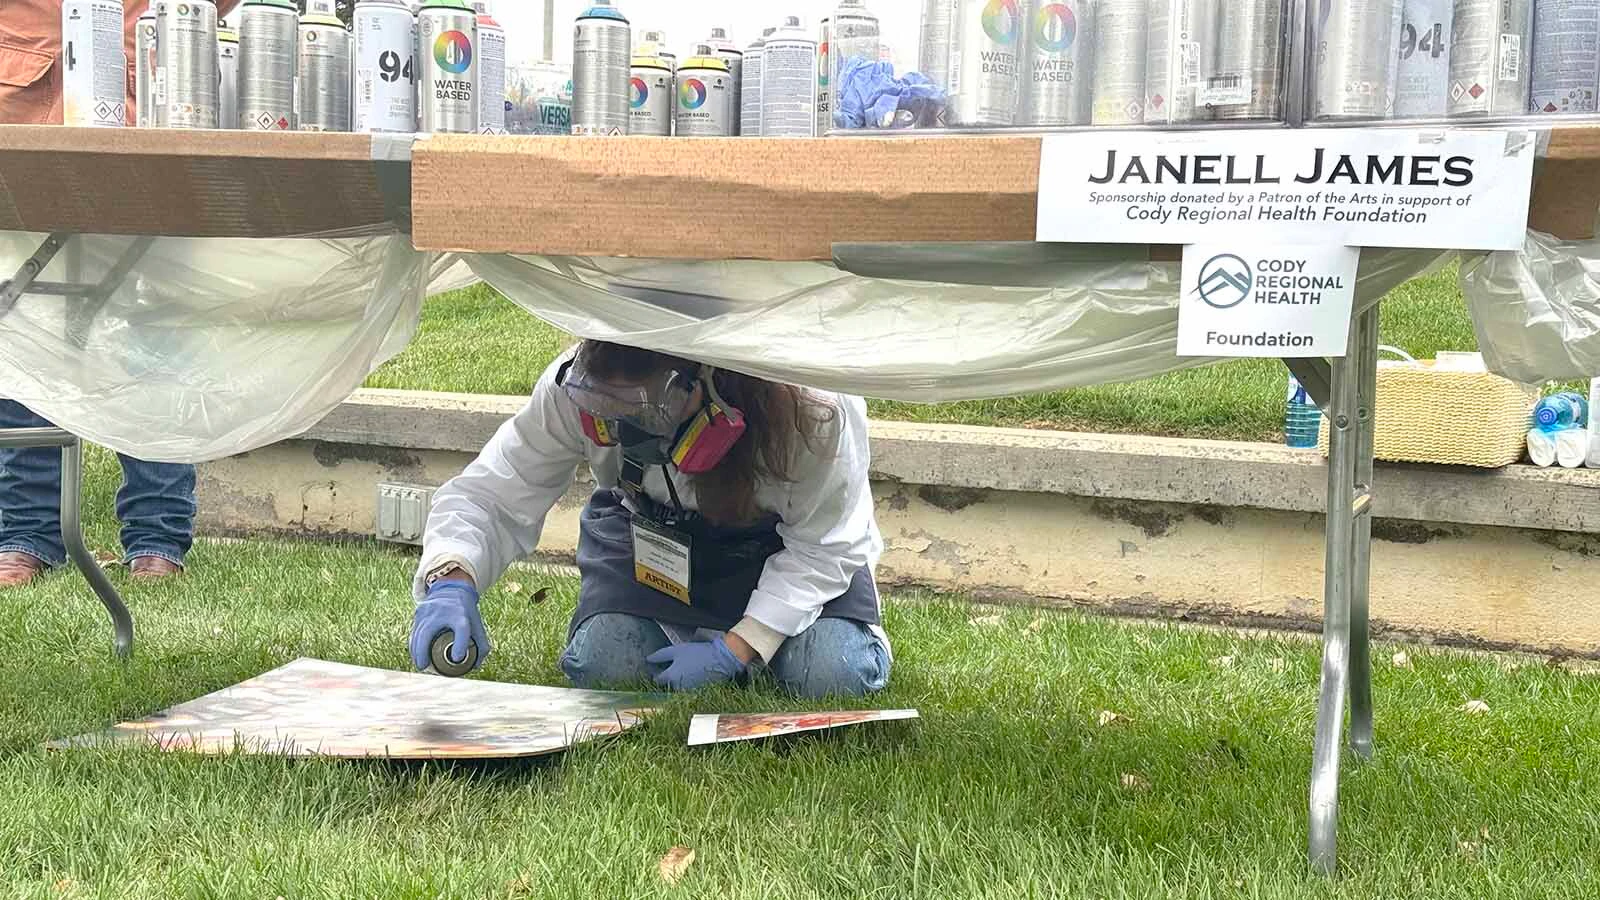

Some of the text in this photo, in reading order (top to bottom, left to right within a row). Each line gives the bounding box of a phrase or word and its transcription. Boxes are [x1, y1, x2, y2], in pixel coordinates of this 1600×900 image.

[1399, 23, 1445, 60] 94
[378, 50, 414, 85] 94
[1032, 60, 1074, 71] WATER
[1033, 72, 1072, 82] BASED
[434, 79, 472, 91] WATER
[436, 90, 471, 101] BASED
[1088, 148, 1474, 187] JANELL JAMES
[1089, 191, 1472, 208] Sponsorship donated by a Patron of the Arts in support of
[1126, 205, 1427, 224] Cody Regional Health Foundation
[1257, 259, 1306, 273] CODY
[1256, 276, 1344, 289] REGIONAL
[1254, 291, 1321, 304] HEALTH
[1206, 331, 1314, 346] Foundation
[645, 572, 681, 595] ARTIST
